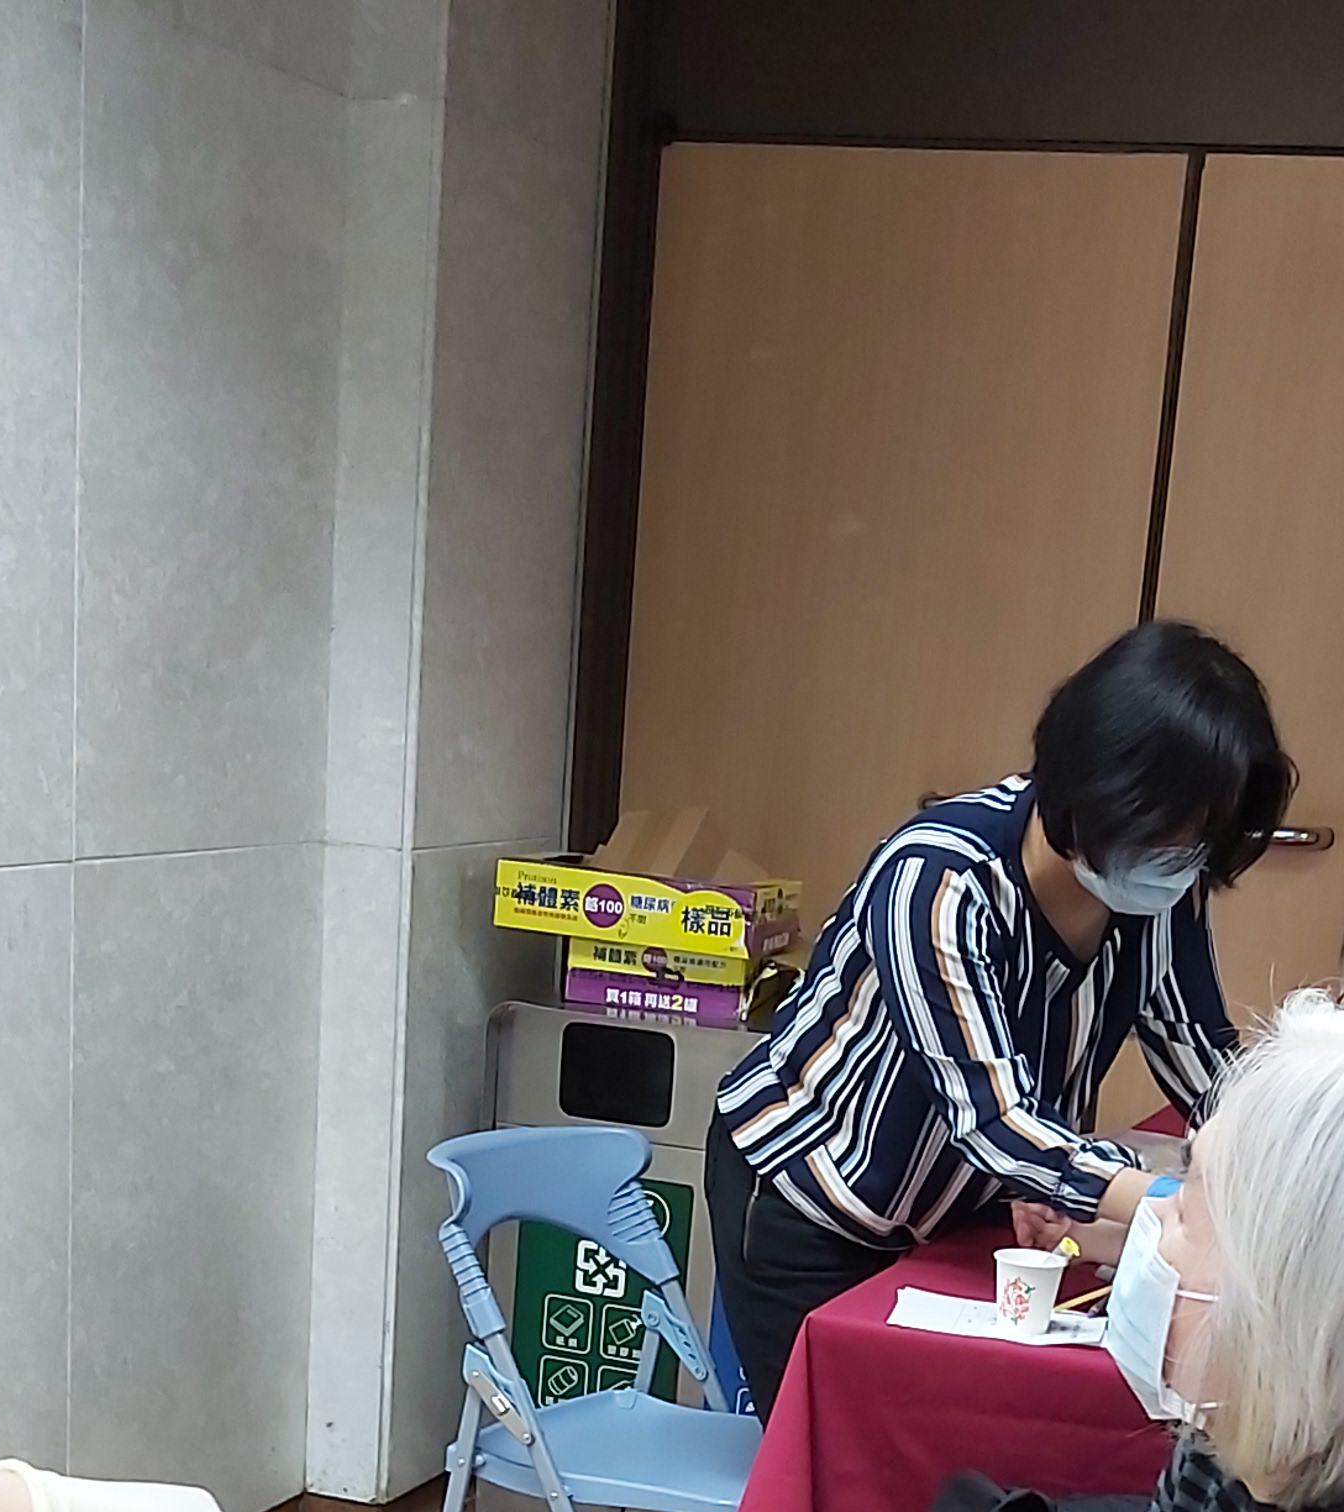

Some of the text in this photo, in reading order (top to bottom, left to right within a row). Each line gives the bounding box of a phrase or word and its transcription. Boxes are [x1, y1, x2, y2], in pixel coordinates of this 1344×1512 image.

[630, 895, 676, 914] 糖尿病
[680, 906, 733, 937] 樣品
